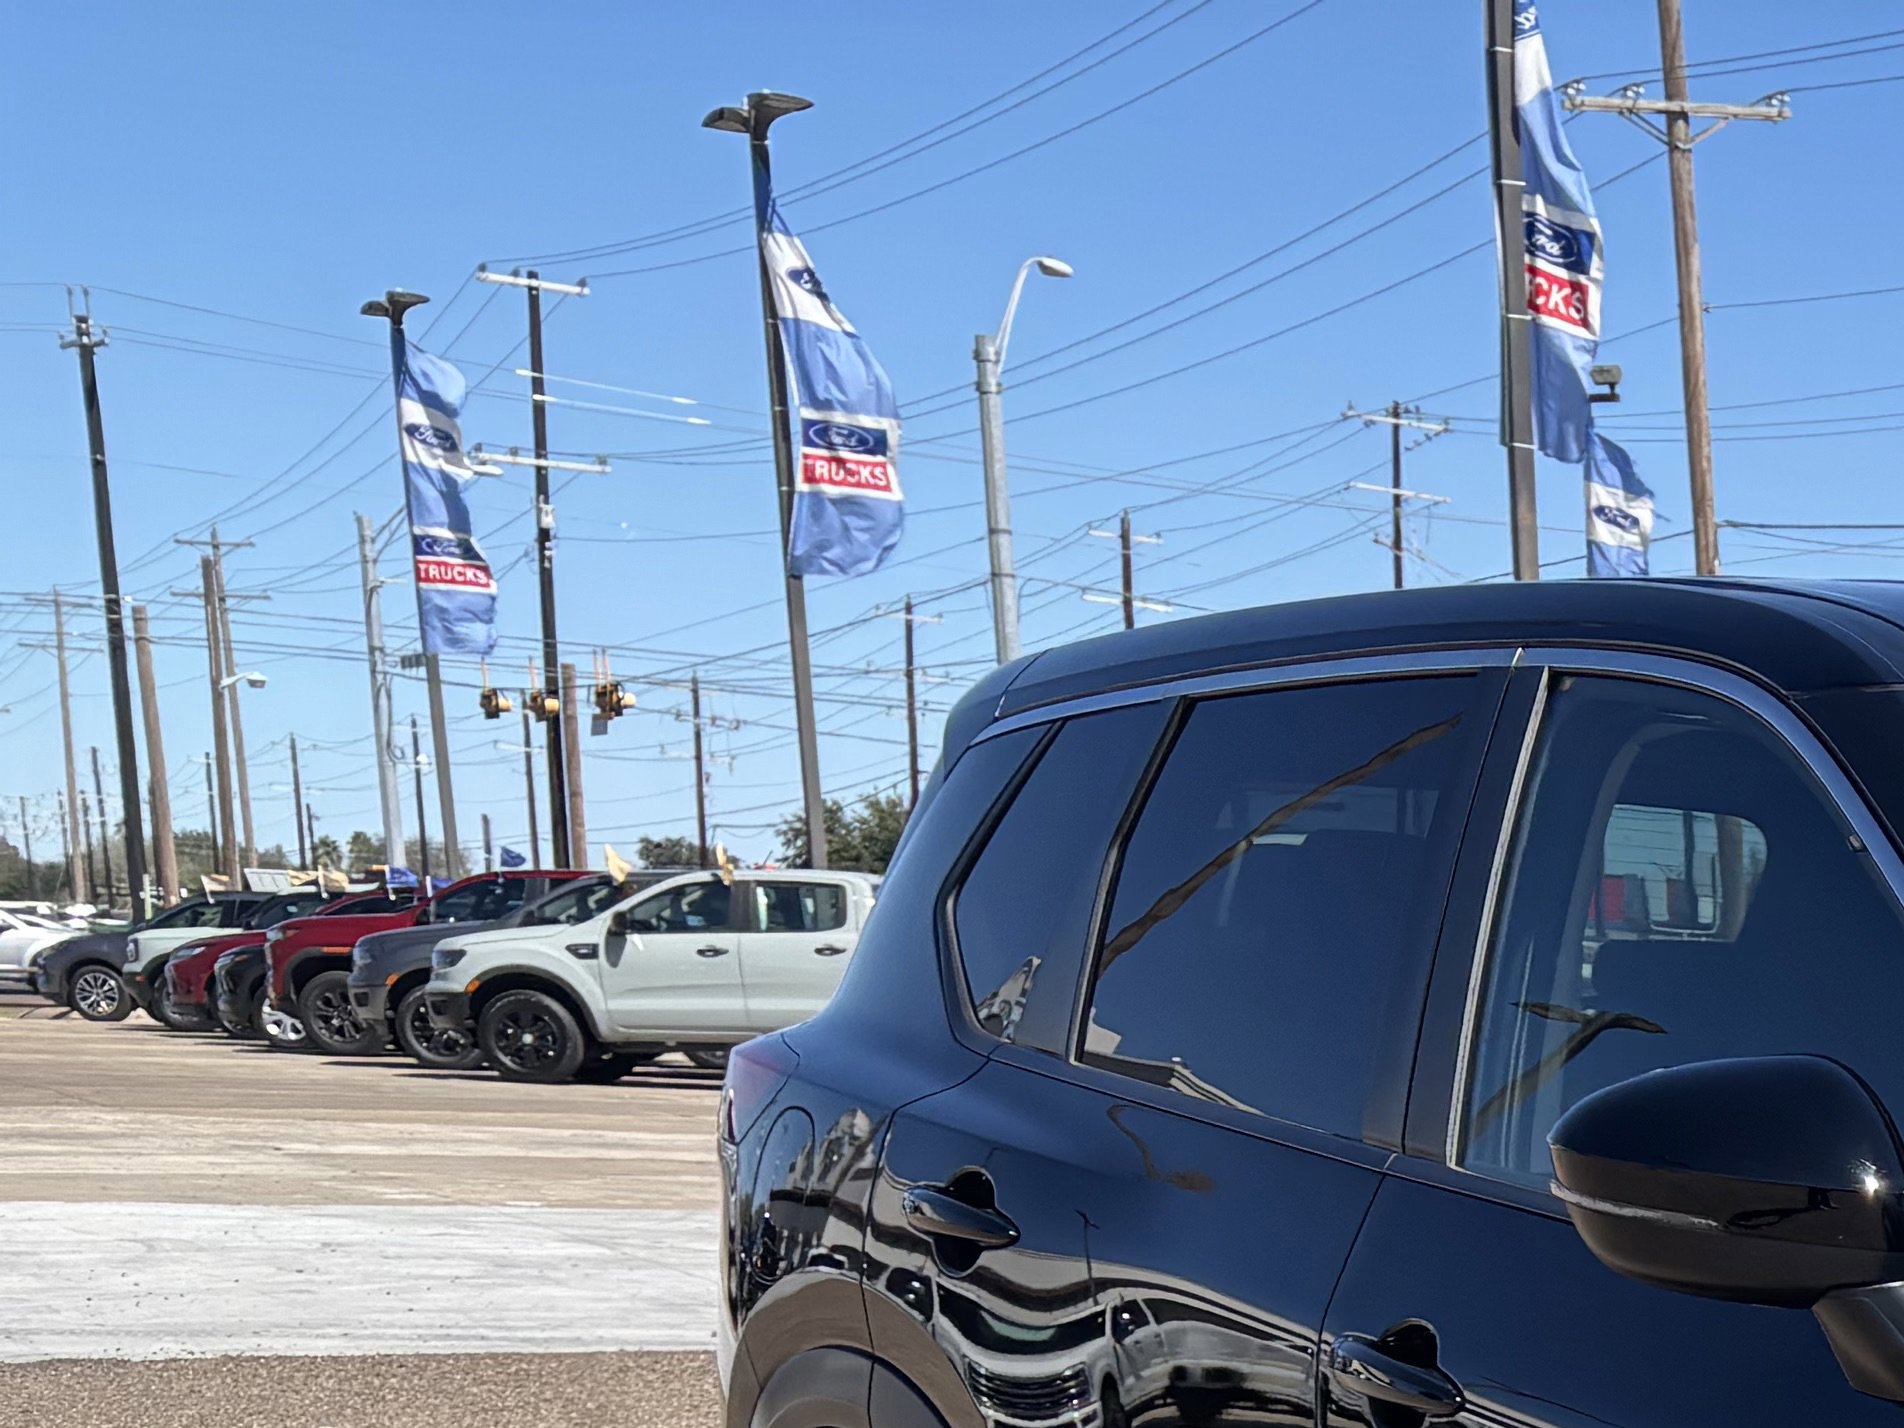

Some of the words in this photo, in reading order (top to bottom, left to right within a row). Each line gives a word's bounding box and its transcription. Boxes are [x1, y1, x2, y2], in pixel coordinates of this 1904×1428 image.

[1525, 272, 1584, 319] CKS
[806, 458, 888, 487] TRUCKS
[417, 562, 489, 585] TRUCKS
